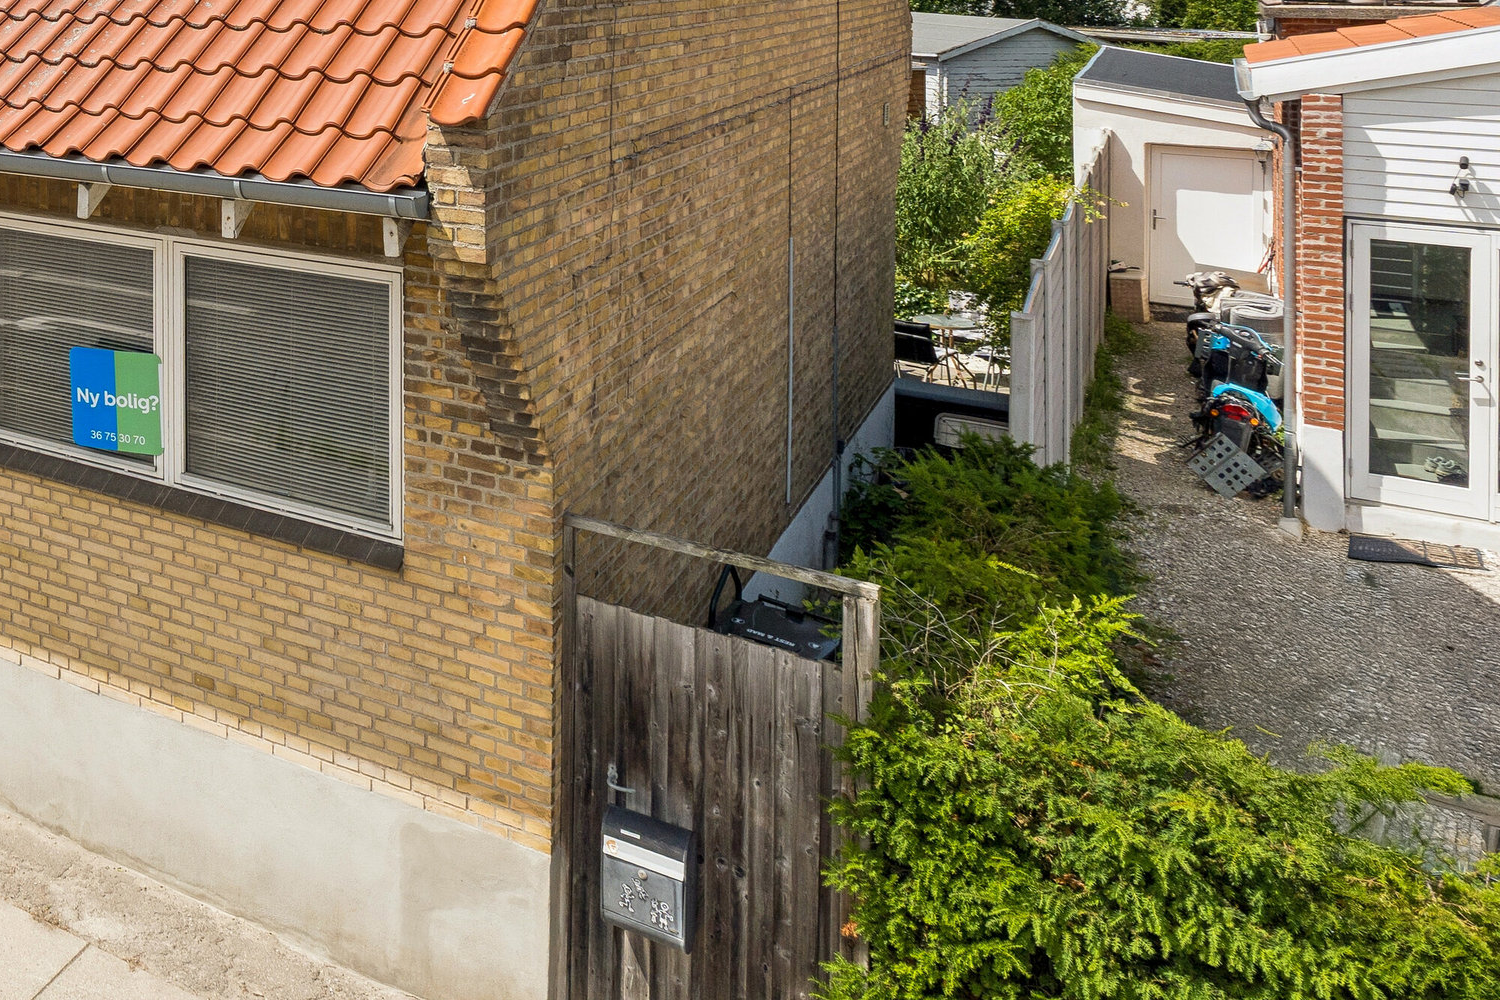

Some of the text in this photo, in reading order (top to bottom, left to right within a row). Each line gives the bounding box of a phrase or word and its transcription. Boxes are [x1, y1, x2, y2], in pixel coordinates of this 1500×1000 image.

[76, 386, 159, 414] Ny bolig?
[90, 430, 145, 445] 36 75 30 70
